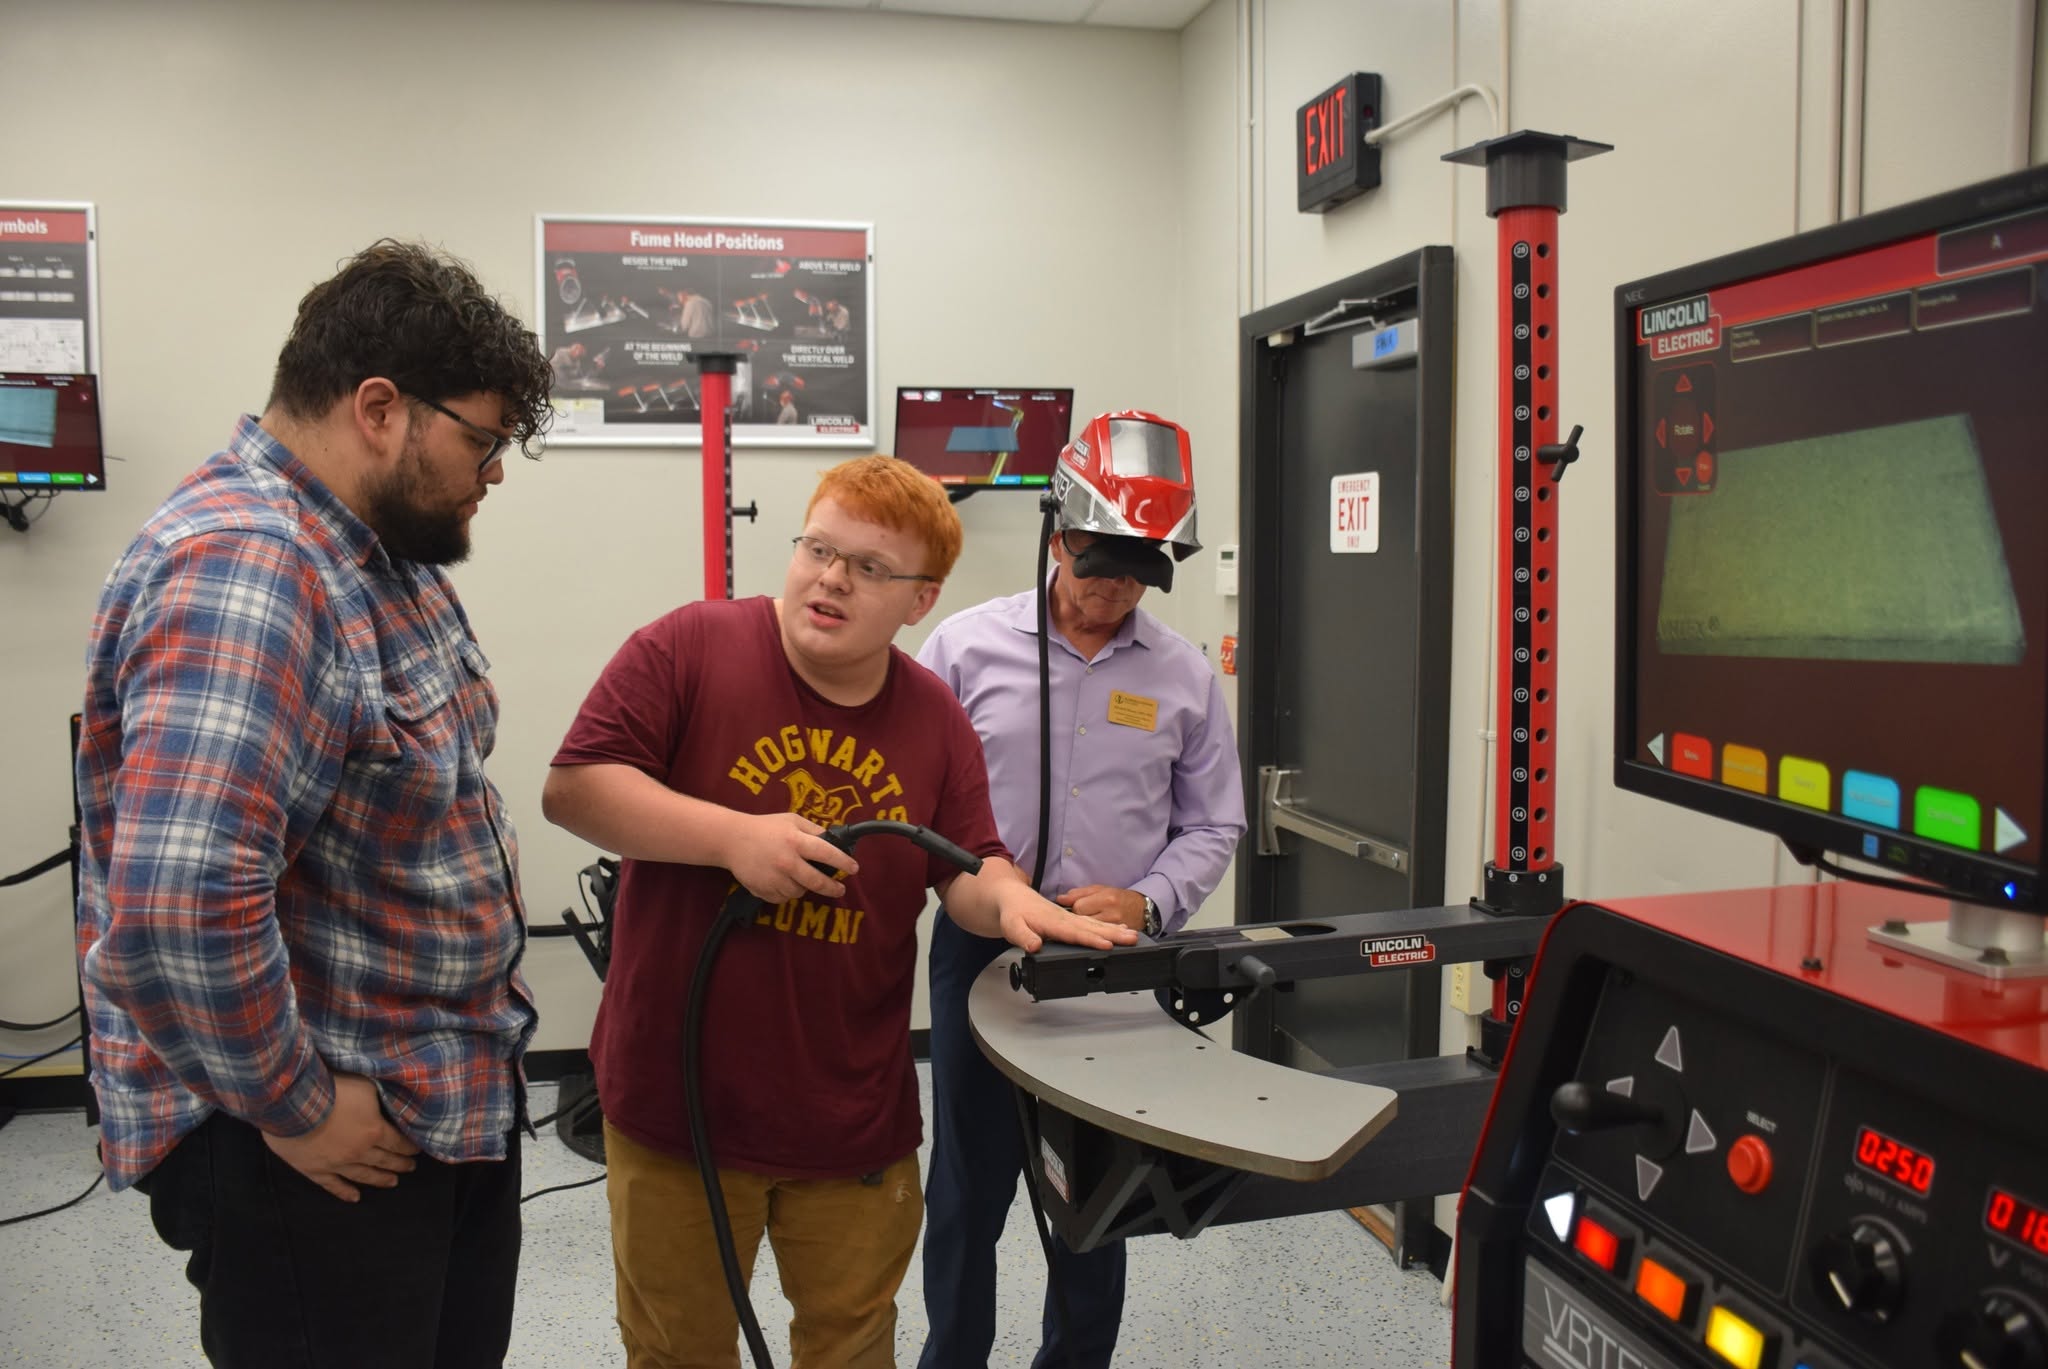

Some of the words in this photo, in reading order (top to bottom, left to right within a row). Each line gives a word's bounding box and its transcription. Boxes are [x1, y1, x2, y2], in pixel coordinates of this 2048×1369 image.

[1305, 86, 1346, 176] EXIT
[630, 230, 672, 247] Fume
[674, 232, 712, 248] Hood
[715, 232, 784, 250] Positions
[622, 256, 649, 266] BESIDE
[650, 256, 664, 266] THE
[666, 257, 688, 267] WELD
[824, 261, 838, 271] THE
[840, 262, 861, 272] WELD
[1624, 288, 1645, 304] NEC
[1644, 300, 1706, 334] LINCOLN
[1658, 328, 1713, 354] ELECTRIC
[1338, 496, 1370, 531] EXIT
[1364, 938, 1422, 953] LINCOLN
[1378, 951, 1428, 964] ELECTRIC
[1858, 1130, 1935, 1193] 0250
